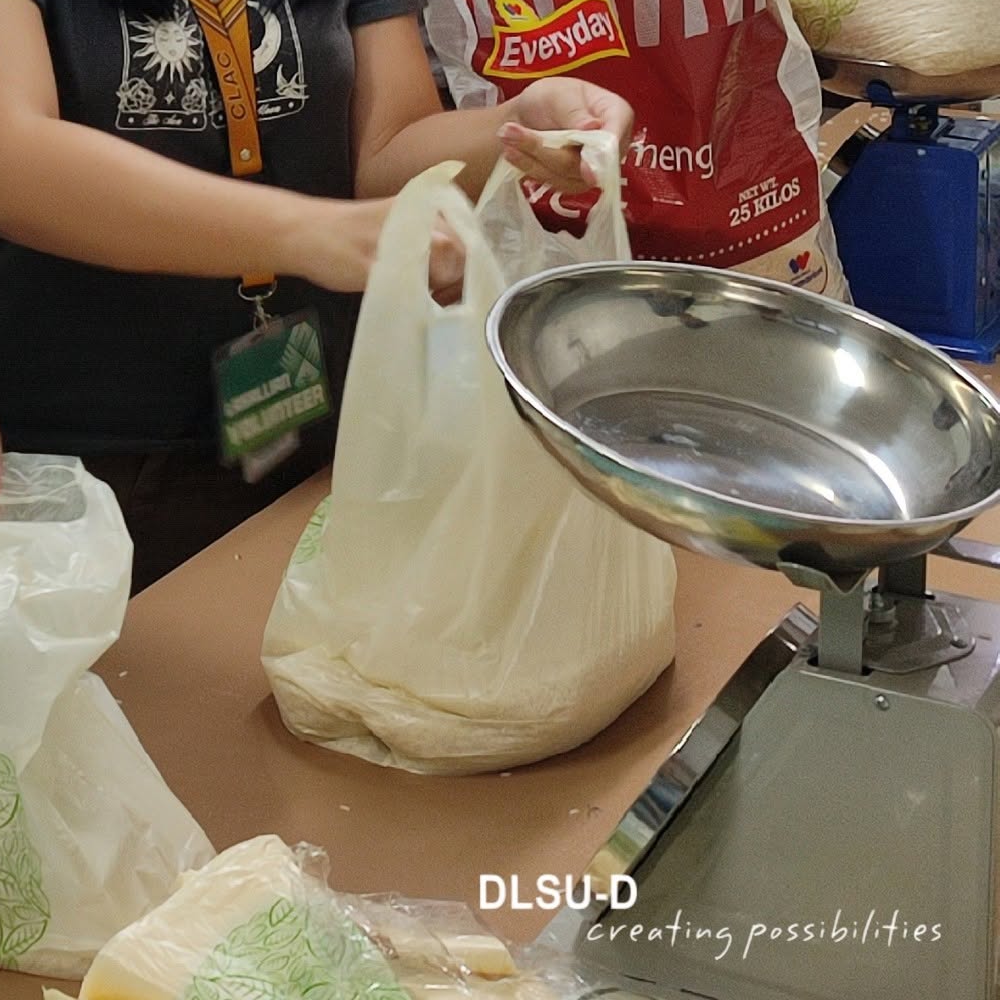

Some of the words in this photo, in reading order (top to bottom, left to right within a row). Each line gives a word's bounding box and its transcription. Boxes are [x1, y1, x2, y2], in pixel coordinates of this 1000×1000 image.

[500, 9, 616, 67] Everyday
[217, 51, 247, 121] CLAC
[729, 203, 751, 227] 25
[753, 177, 801, 218] KILOS
[739, 185, 759, 203] NET
